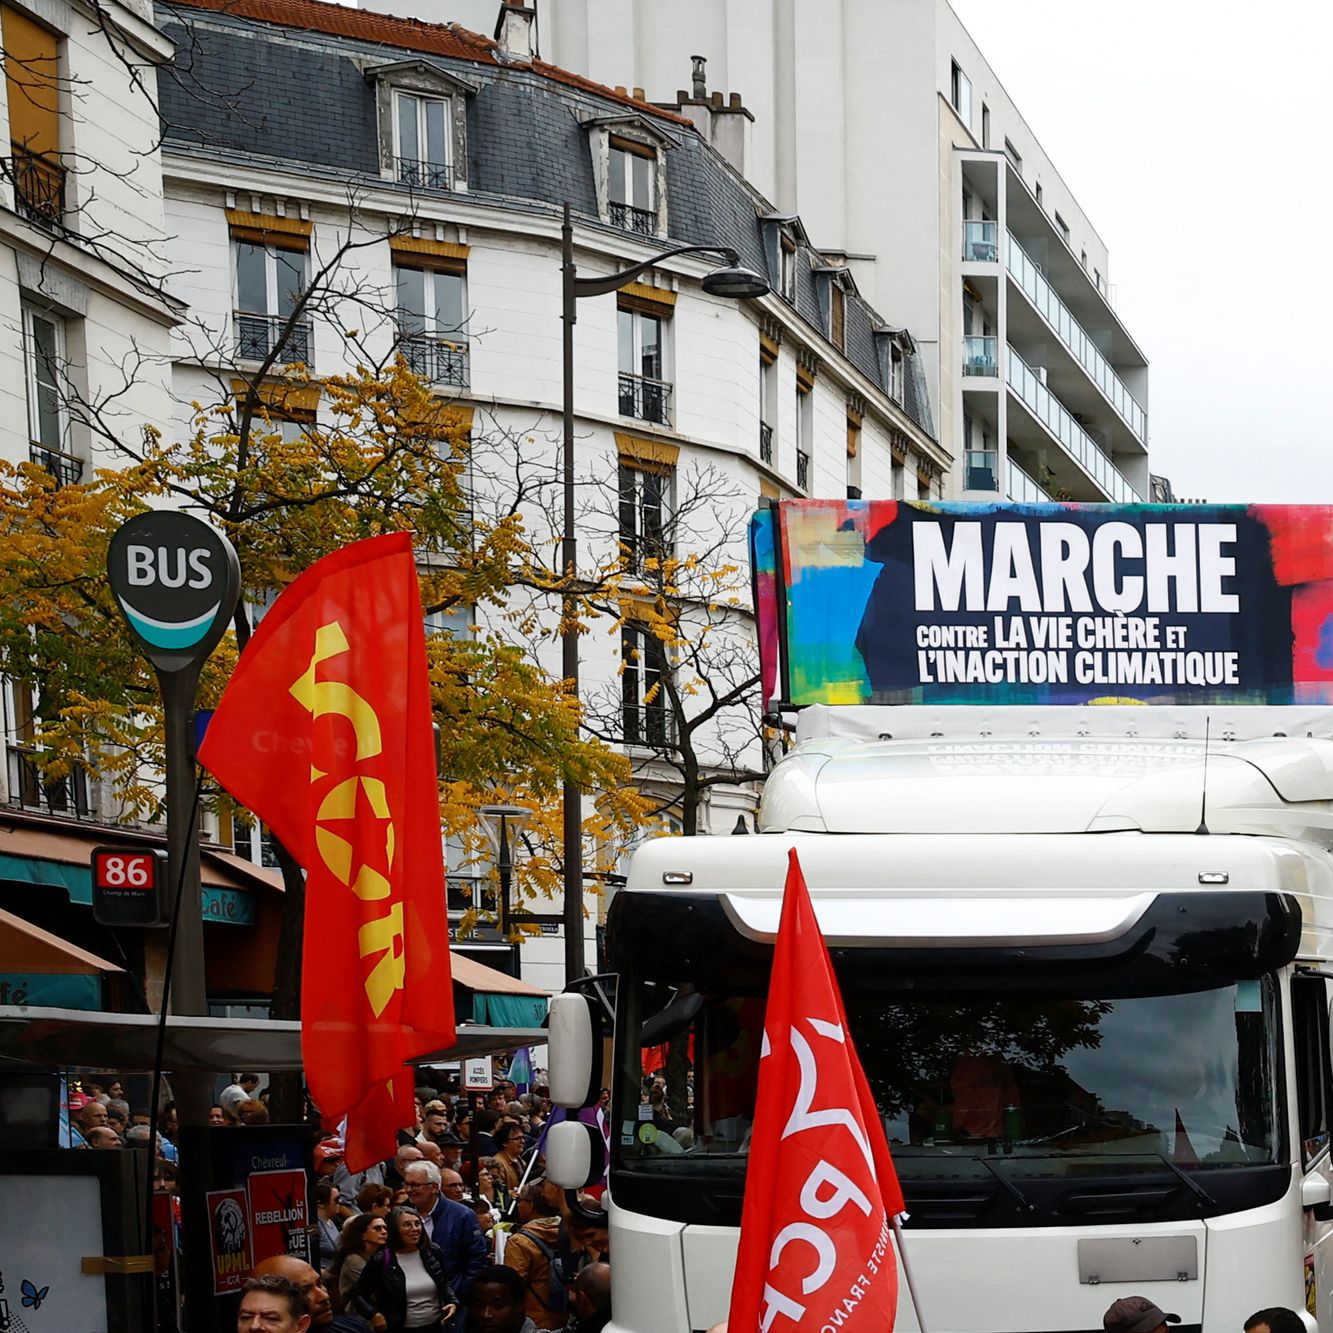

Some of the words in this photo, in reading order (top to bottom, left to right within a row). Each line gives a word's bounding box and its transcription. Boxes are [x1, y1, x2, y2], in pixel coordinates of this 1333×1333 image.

[126, 545, 213, 590] BUS
[912, 520, 1240, 614] MARCHE
[916, 625, 988, 648] CONTRE
[993, 615, 1028, 649] LA
[1029, 615, 1073, 649] VIE
[1076, 609, 1160, 649] CHÈRE
[1165, 625, 1187, 649] ET
[1074, 651, 1240, 686] CLIMATIQUE
[105, 857, 148, 886] 86
[255, 1208, 304, 1225] REBELLION
[296, 1200, 304, 1208] La
[217, 1251, 250, 1274] UPML
